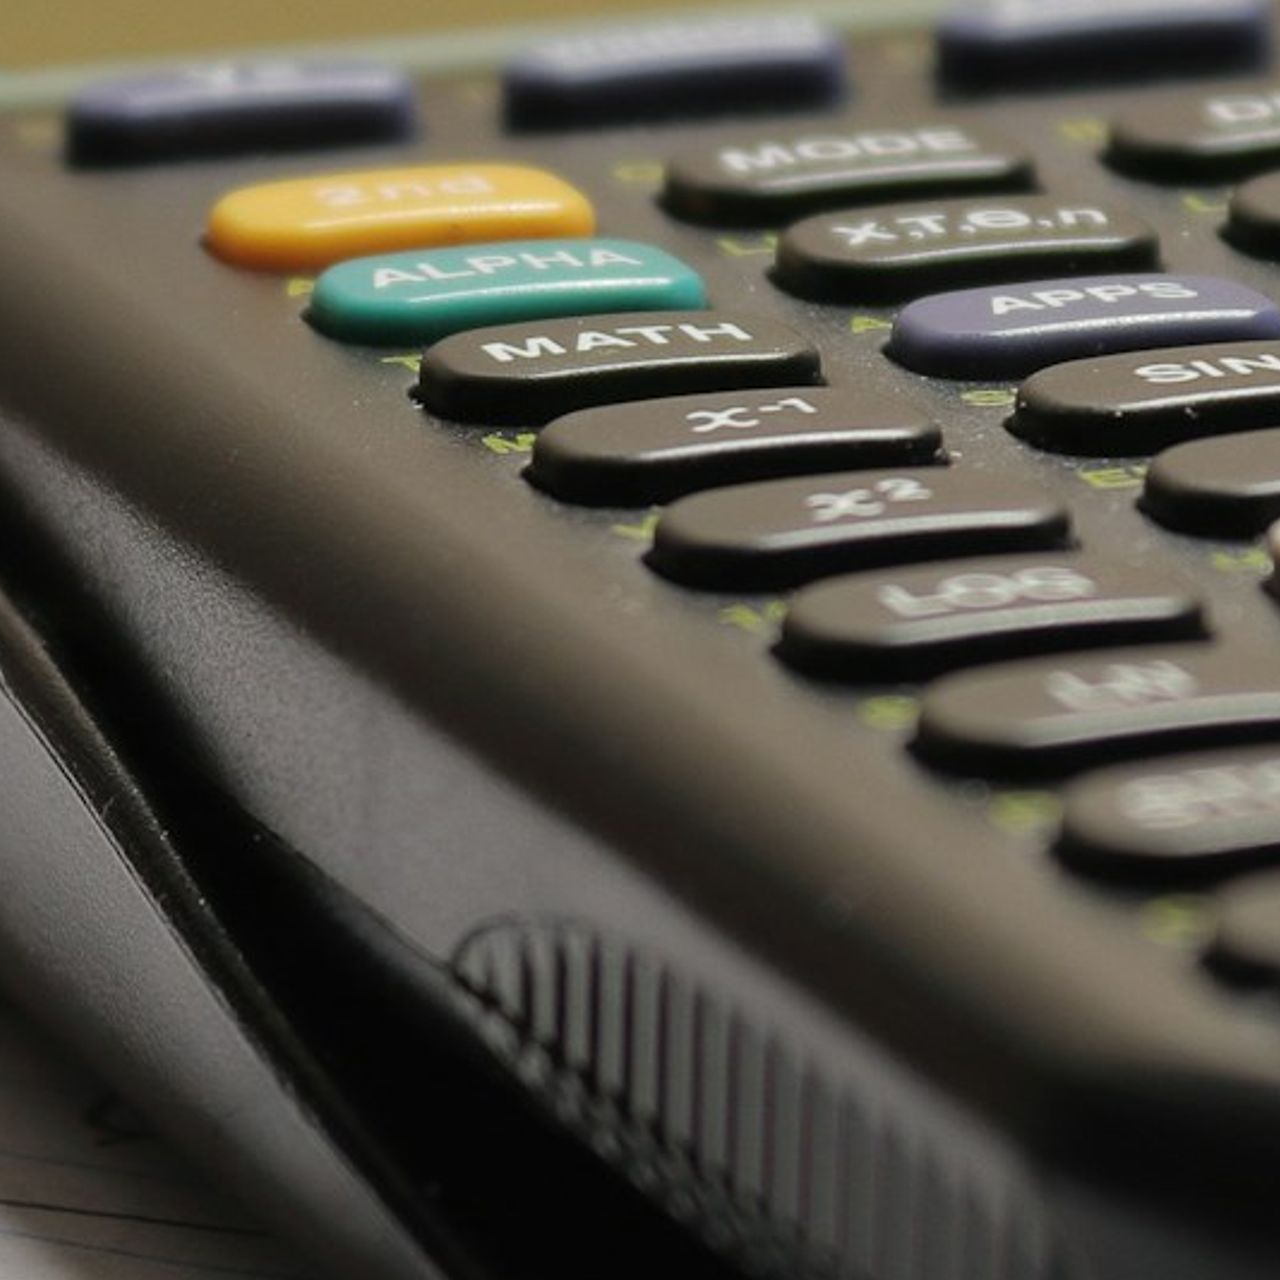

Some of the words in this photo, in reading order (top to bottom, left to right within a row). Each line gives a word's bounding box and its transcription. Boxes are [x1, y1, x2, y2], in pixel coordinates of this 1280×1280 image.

[722, 130, 977, 171] MODE
[316, 172, 494, 206] 2nd
[372, 245, 644, 290] ALPHA
[990, 282, 1200, 315] APPS
[481, 322, 753, 363] MATH
[877, 567, 1097, 618] LOG
